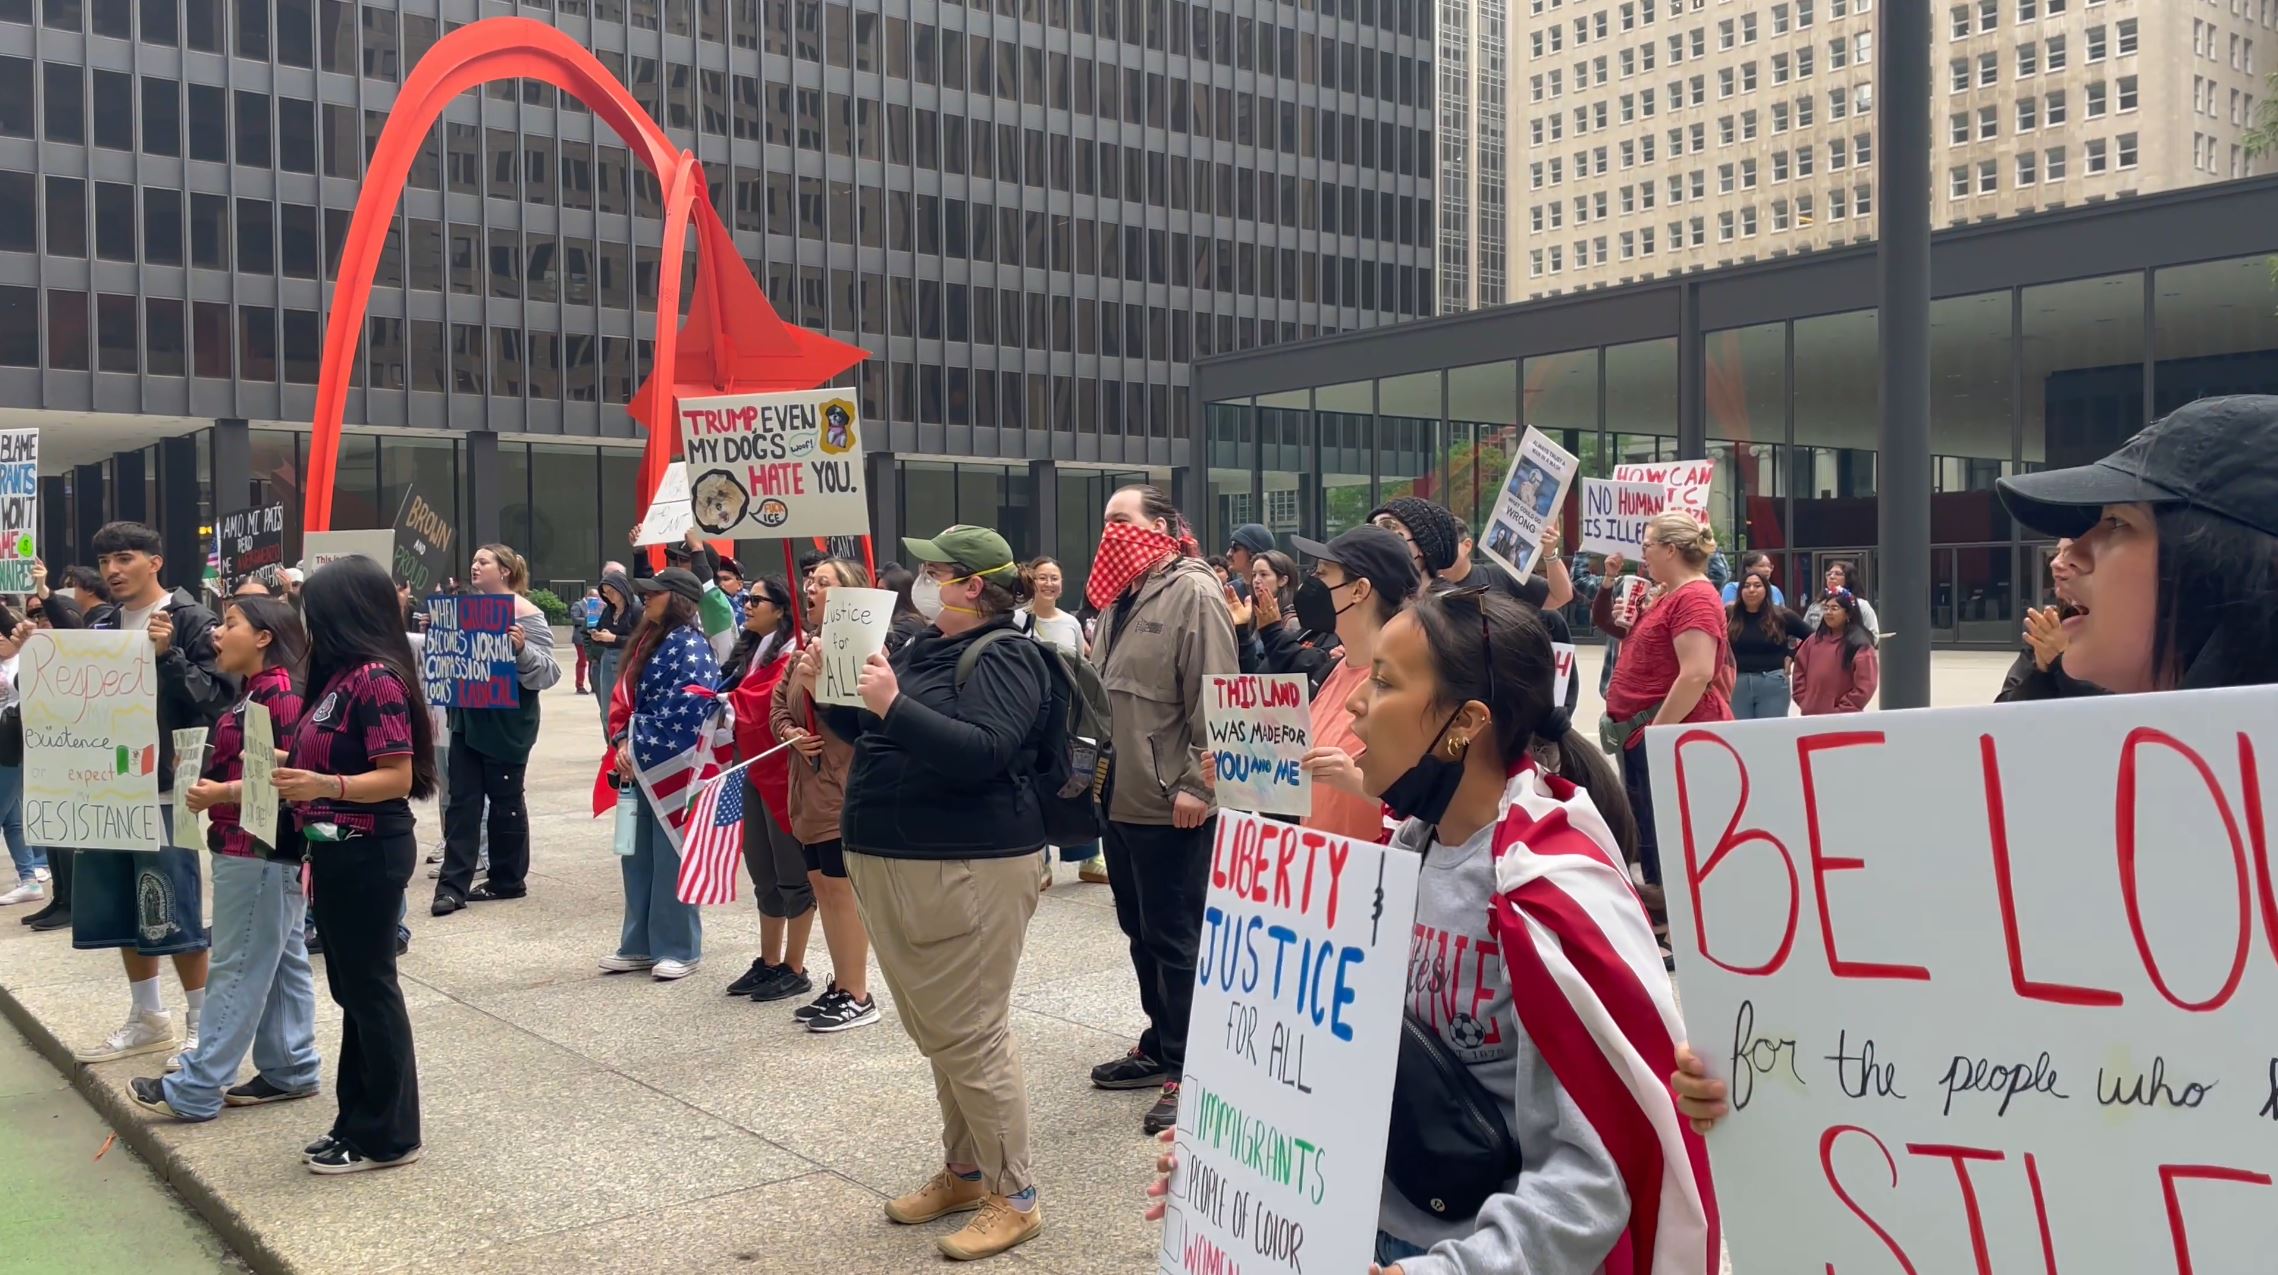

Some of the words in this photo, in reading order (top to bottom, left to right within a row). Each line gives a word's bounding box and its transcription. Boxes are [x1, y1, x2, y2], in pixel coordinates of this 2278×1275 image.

[683, 405, 758, 436] TRUMP,
[762, 404, 816, 433] EVEN
[1, 434, 37, 462] BLAME
[688, 438, 723, 464] MY
[724, 433, 786, 463] DOGS
[748, 463, 804, 496] HATE
[811, 461, 858, 494] YOU.
[1617, 467, 1667, 483] HOW
[1670, 466, 1713, 486] CAN
[764, 503, 785, 513] FUCK
[1588, 485, 1612, 516] NO
[1619, 487, 1665, 516] HUMAN
[224, 513, 244, 539] AMO
[247, 510, 260, 535] MI
[405, 495, 452, 552] BROWN
[763, 513, 781, 523] ICE
[1506, 505, 1536, 534] WRONG
[1584, 519, 1601, 538] IS
[413, 538, 427, 556] AND
[394, 545, 429, 590] PROUD
[427, 598, 457, 630] WHEN
[824, 600, 872, 625] Justice
[427, 629, 467, 654] BECOMES
[833, 633, 849, 649] for
[20, 633, 155, 724] Respect
[425, 655, 491, 682] COMPASSION
[424, 678, 452, 704] LOOKS
[1214, 676, 1257, 709] THIS
[1259, 677, 1300, 708] LAND
[1209, 720, 1246, 742] WAS
[1250, 722, 1280, 744] MADE
[1282, 725, 1306, 746] FOR
[68, 763, 115, 786] expect
[1212, 750, 1249, 782] YOU
[1250, 756, 1271, 774] AND
[1274, 759, 1300, 786] ME
[27, 800, 155, 840] RESISTANCE
[1675, 728, 1931, 982] BE
[1212, 815, 1349, 930] LIBERTY
[1200, 906, 1365, 1042] JUSTICE
[1226, 1001, 1258, 1066] FOR
[1269, 1021, 1312, 1094] ALL
[1731, 1000, 1806, 1111] for
[1824, 1030, 1907, 1100] the
[1938, 1051, 2070, 1117] people
[2097, 1056, 2221, 1108] who
[1198, 1087, 1325, 1205] IMMIGRANTS
[1188, 1154, 1228, 1229] PEOPLE
[1232, 1190, 1250, 1239] OF
